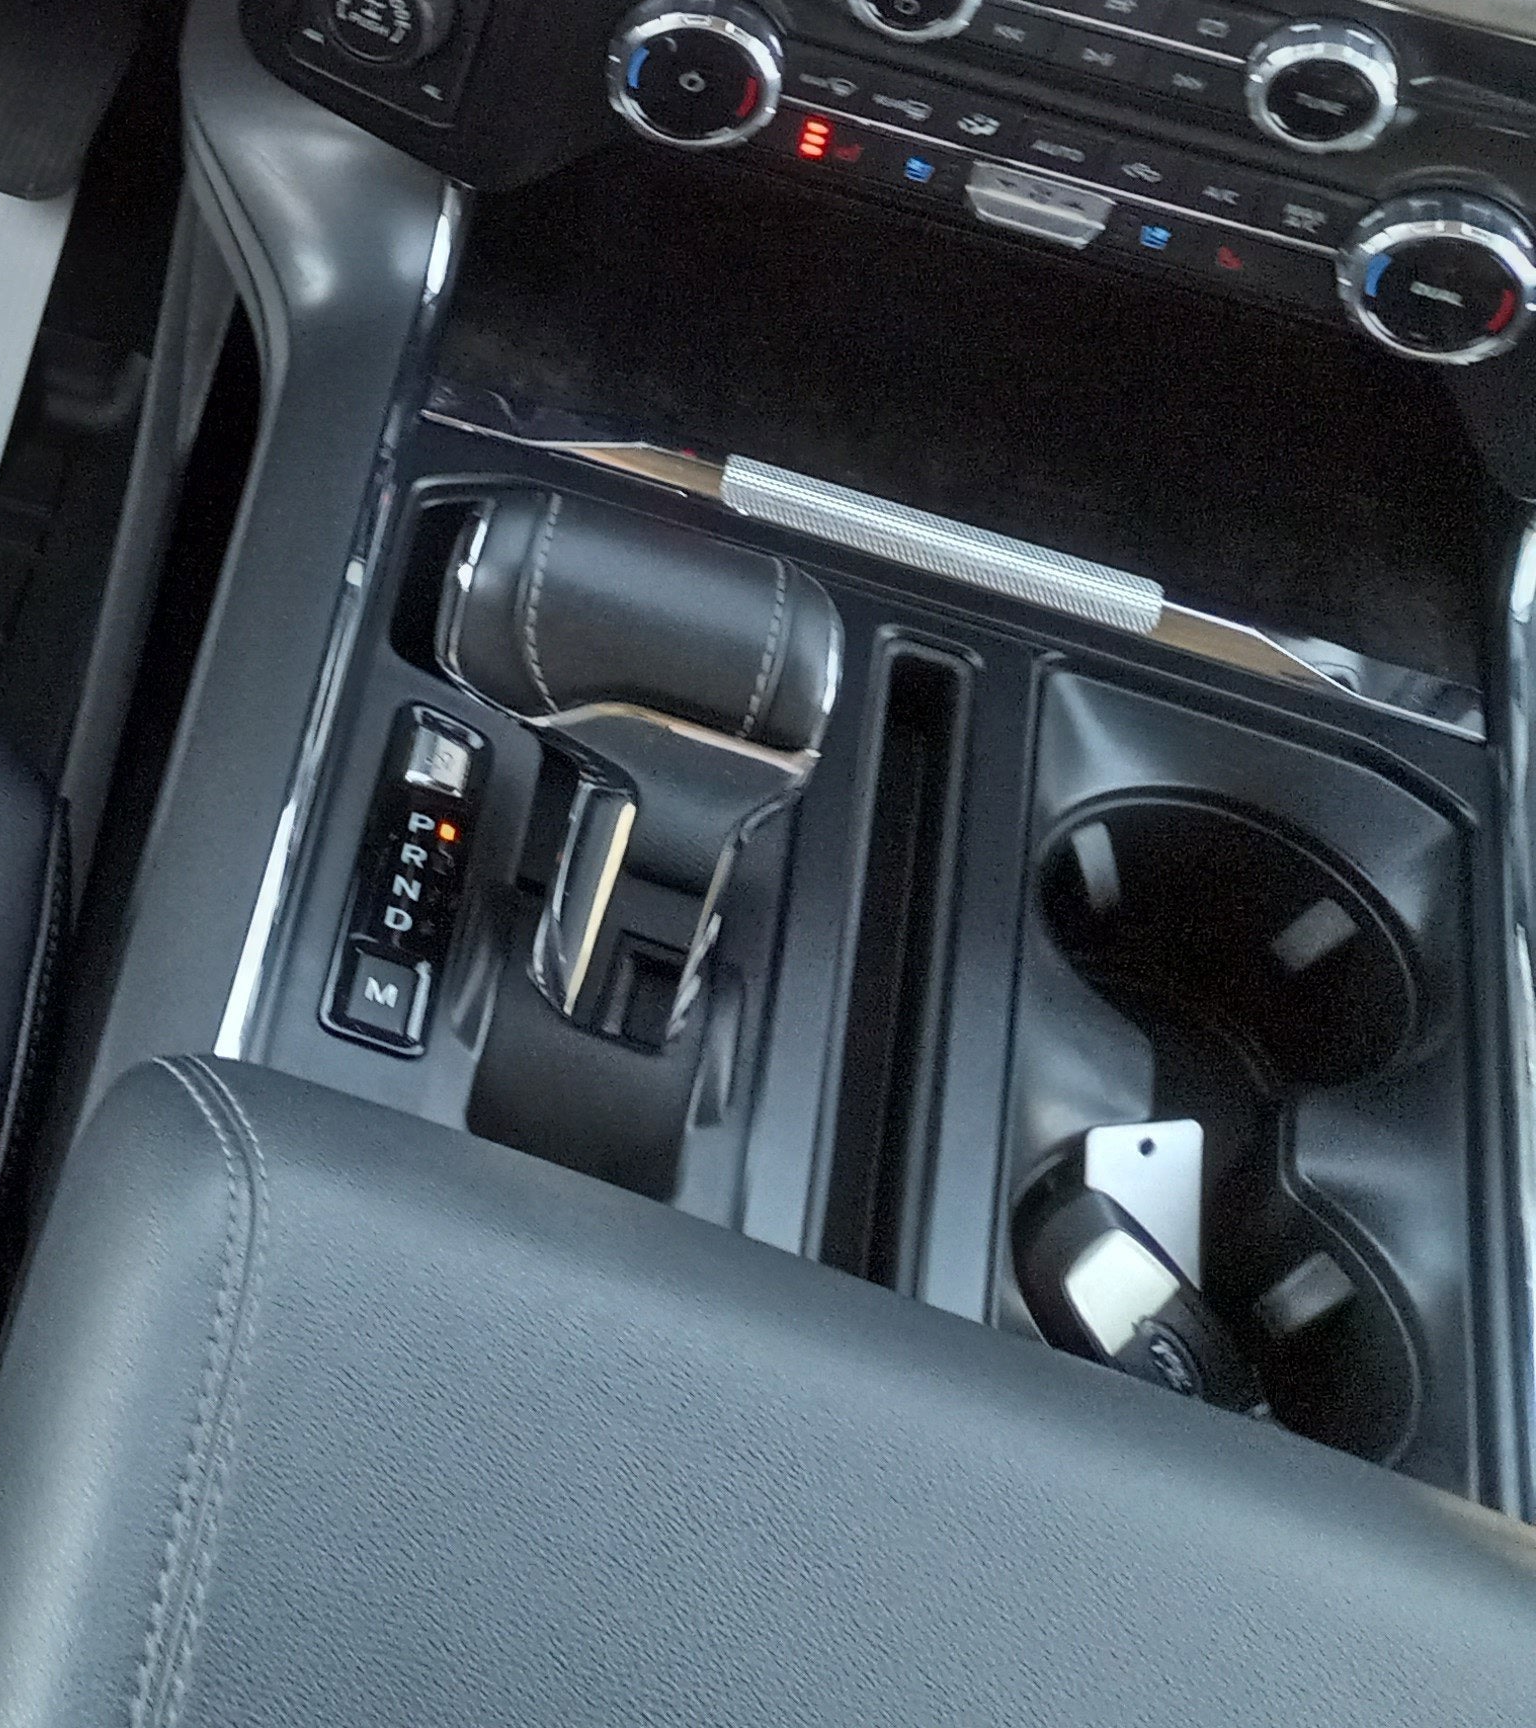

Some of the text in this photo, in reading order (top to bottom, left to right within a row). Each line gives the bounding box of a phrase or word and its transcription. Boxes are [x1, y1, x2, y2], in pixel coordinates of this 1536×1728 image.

[408, 812, 436, 833] P
[401, 842, 428, 869] R
[392, 874, 421, 902] N
[384, 905, 413, 932] D
[363, 976, 399, 1009] M
